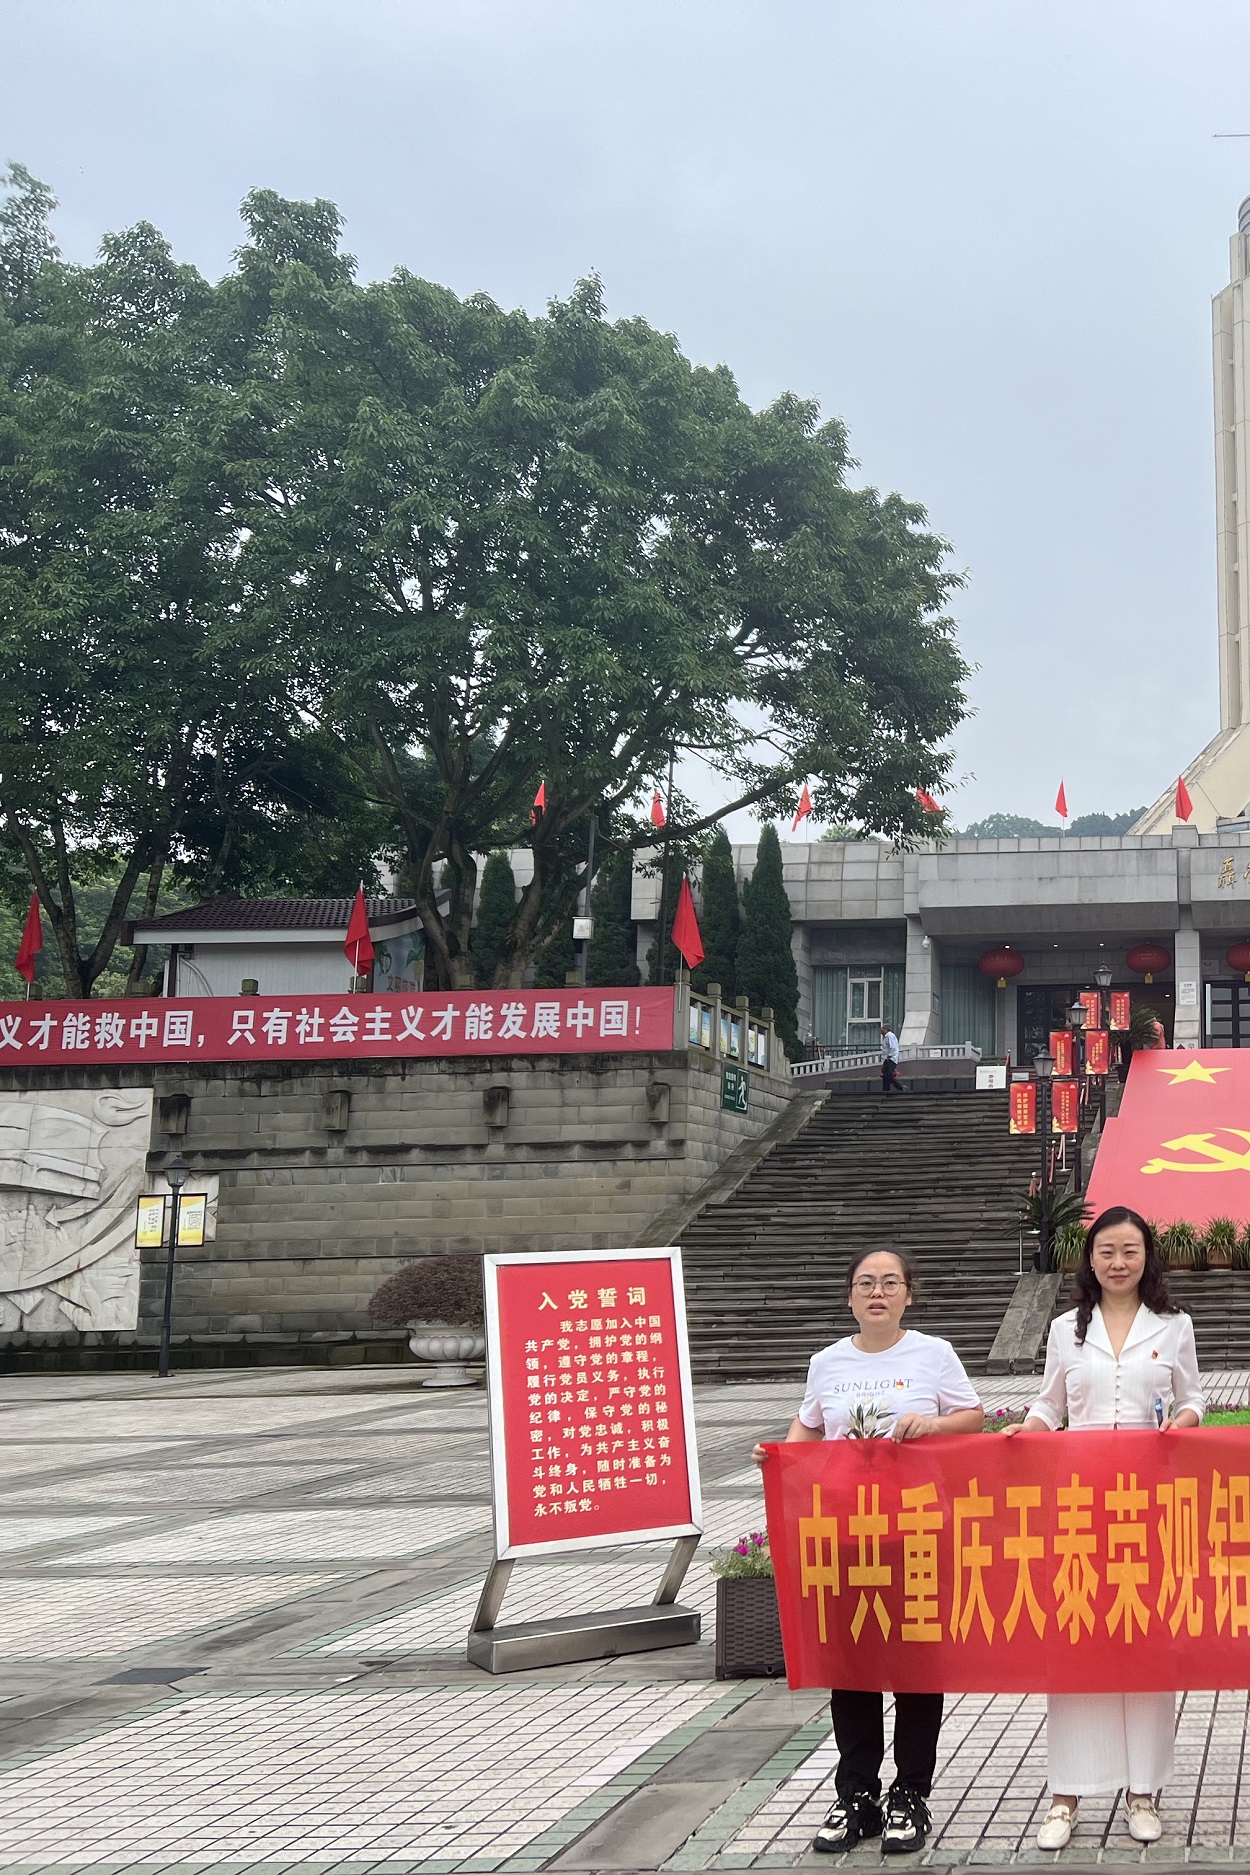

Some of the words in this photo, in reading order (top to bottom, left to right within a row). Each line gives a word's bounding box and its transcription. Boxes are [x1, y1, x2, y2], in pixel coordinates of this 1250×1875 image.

[538, 1287, 646, 1311] 入党誓词
[560, 1315, 661, 1333] 我志愿加入中国
[525, 1332, 663, 1353] 共产党，拥护党的纲
[525, 1350, 657, 1371] 领，遵守党的章程，
[527, 1366, 665, 1388] 履行党员义务，执行
[528, 1384, 666, 1406] 党的决定，严守党的
[856, 1390, 885, 1398] BRIGHT
[529, 1401, 668, 1424] 纪律，保守党的秘
[530, 1418, 669, 1443] 密，对党忠诚，积极
[531, 1435, 671, 1461] 工作，为共产主义奋
[532, 1453, 672, 1480] 斗终身，随时准备为
[533, 1473, 667, 1498] 党和人民牺牲一切，
[534, 1498, 600, 1517] 永不叛党。
